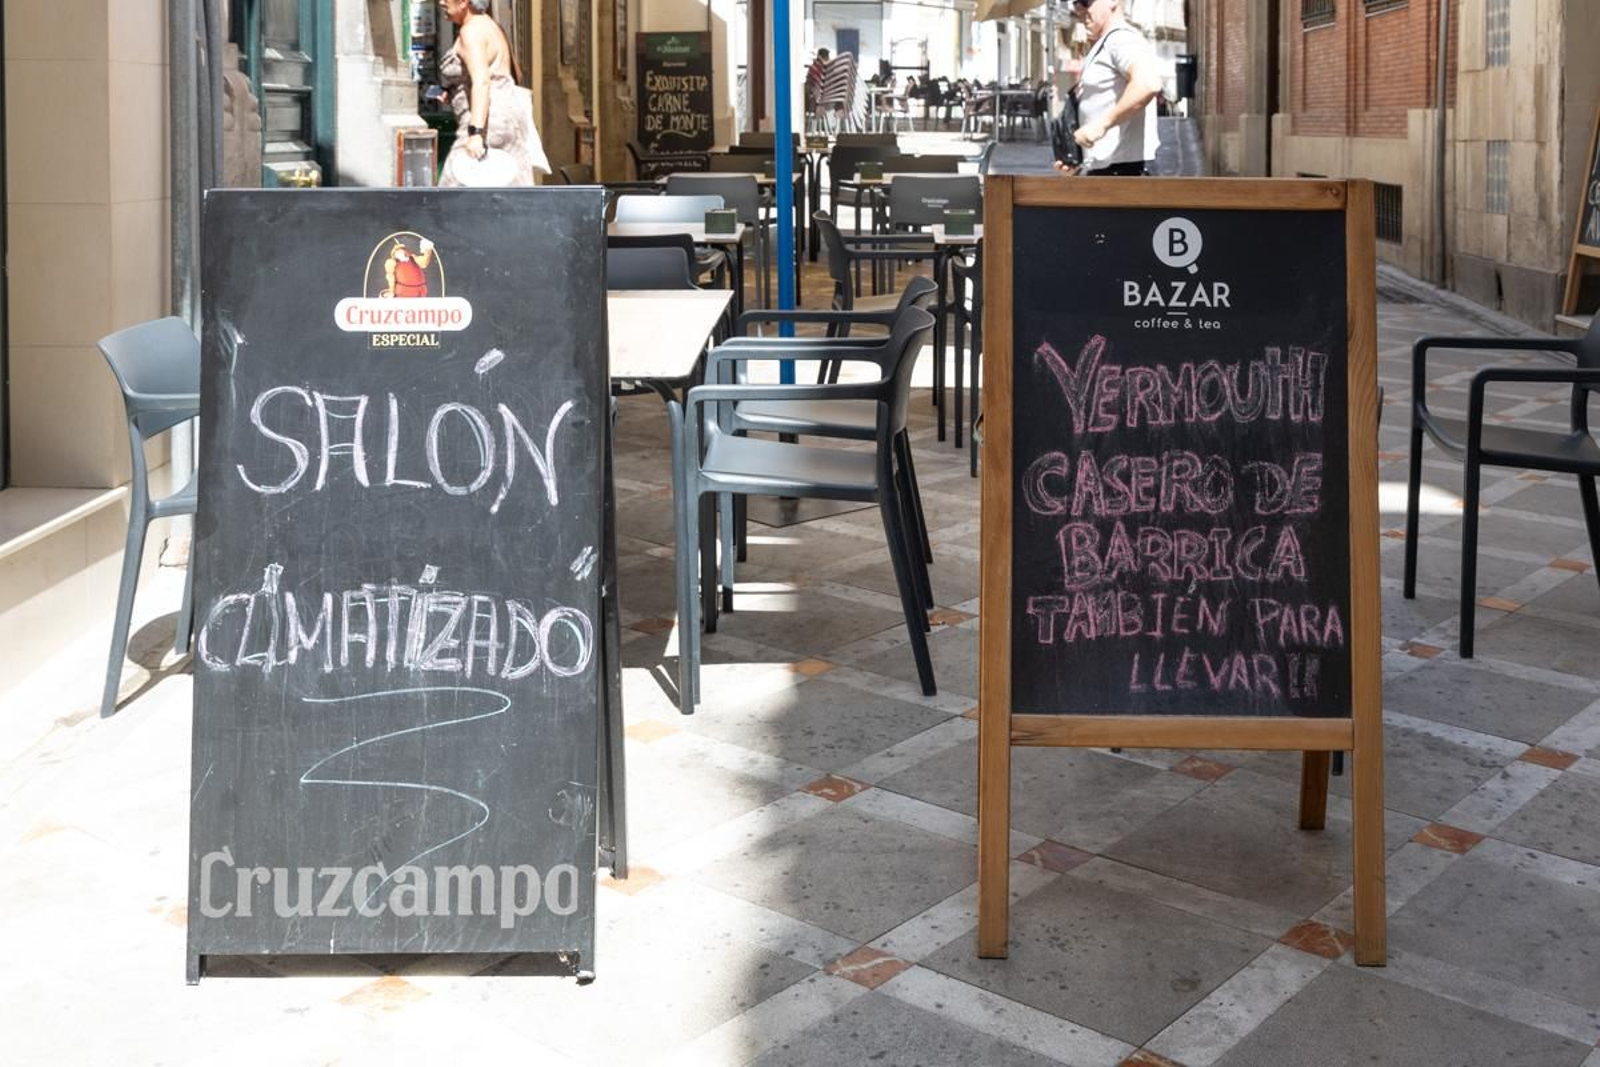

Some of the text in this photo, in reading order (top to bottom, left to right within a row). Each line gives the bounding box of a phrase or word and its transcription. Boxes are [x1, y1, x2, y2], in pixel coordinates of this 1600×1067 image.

[648, 93, 691, 112] CARNE
[645, 113, 710, 131] DE MONTE
[1123, 281, 1231, 308] BAZAR
[345, 305, 463, 327] Cruzcampo
[1134, 317, 1221, 329] coffee & tea
[372, 333, 439, 347] ESPECIAL
[1022, 450, 1323, 517] CASERO DE
[1056, 520, 1305, 590] BARRICA
[1248, 597, 1344, 649] PARA
[200, 846, 579, 929] Cruzcampo
